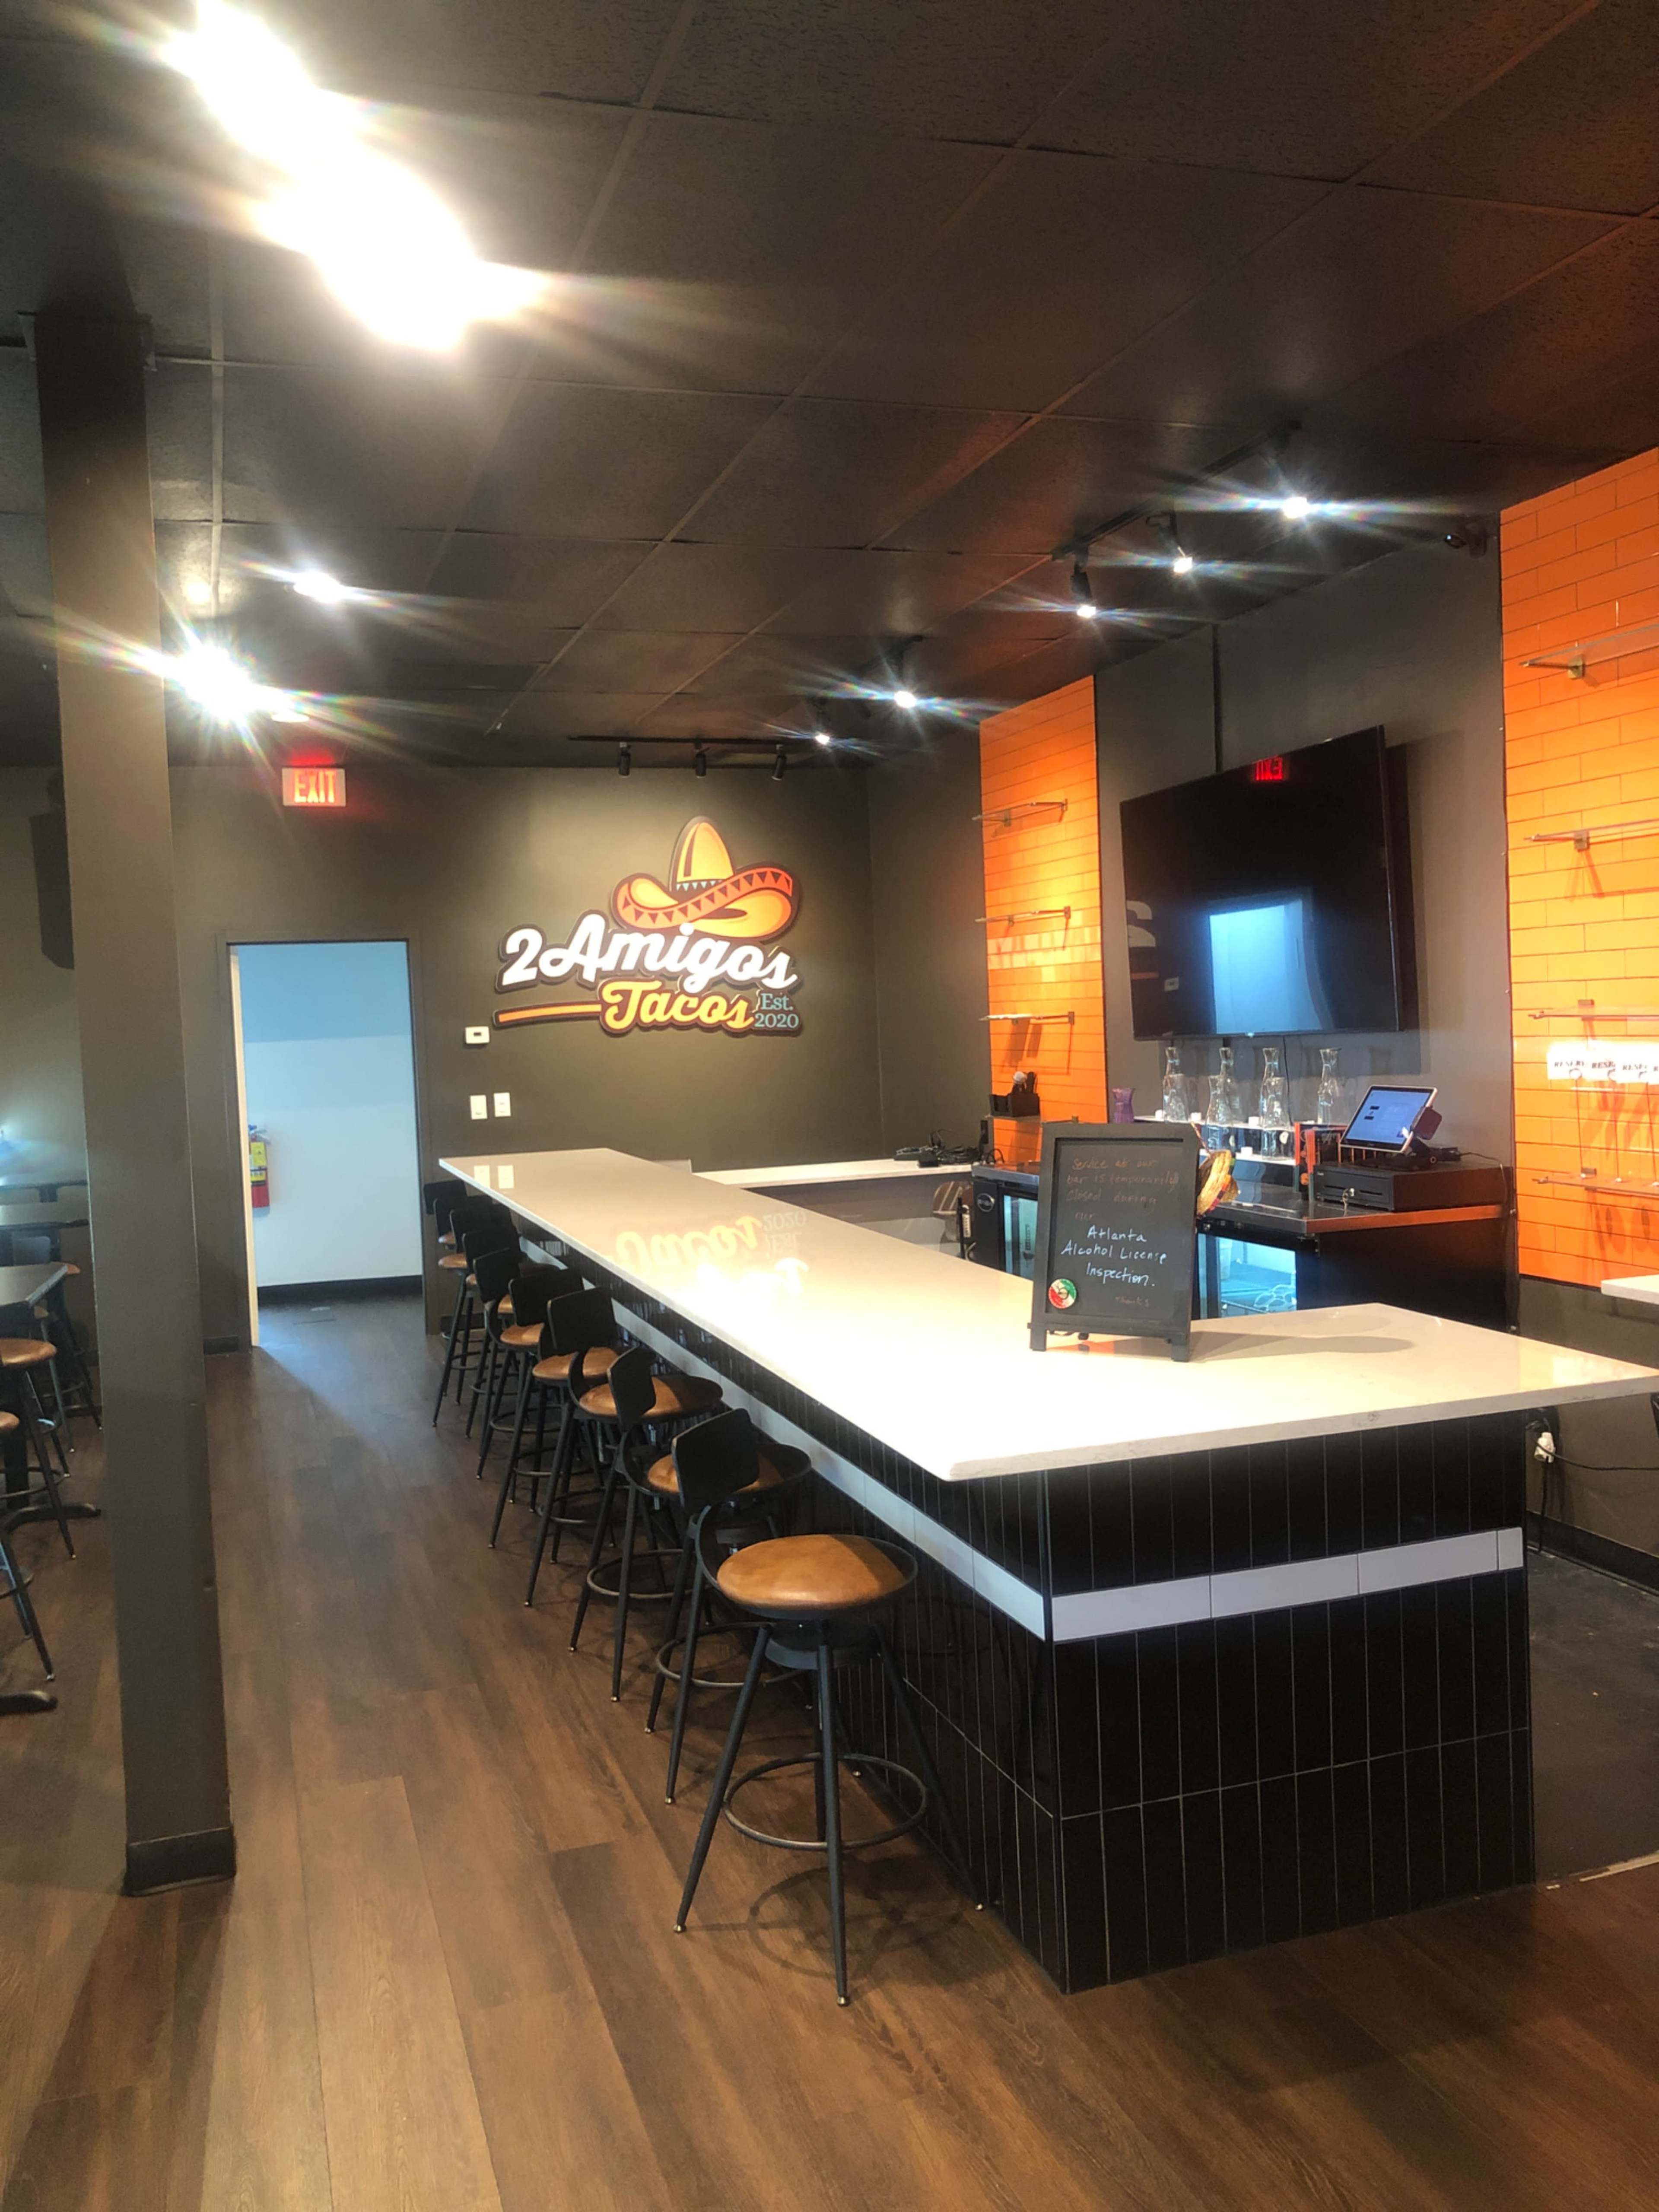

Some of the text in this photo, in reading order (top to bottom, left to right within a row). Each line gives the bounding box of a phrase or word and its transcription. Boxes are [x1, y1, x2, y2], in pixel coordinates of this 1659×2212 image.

[294, 771, 335, 803] EXIT
[601, 980, 754, 1030] Tacos
[760, 993, 793, 1011] Est.
[754, 1014, 799, 1028] 2020
[1066, 1175, 1087, 1184] bar
[1087, 1225, 1147, 1242] Atlanta
[1061, 1239, 1166, 1264] Alcohol License
[1086, 1262, 1155, 1287] Inspection.
